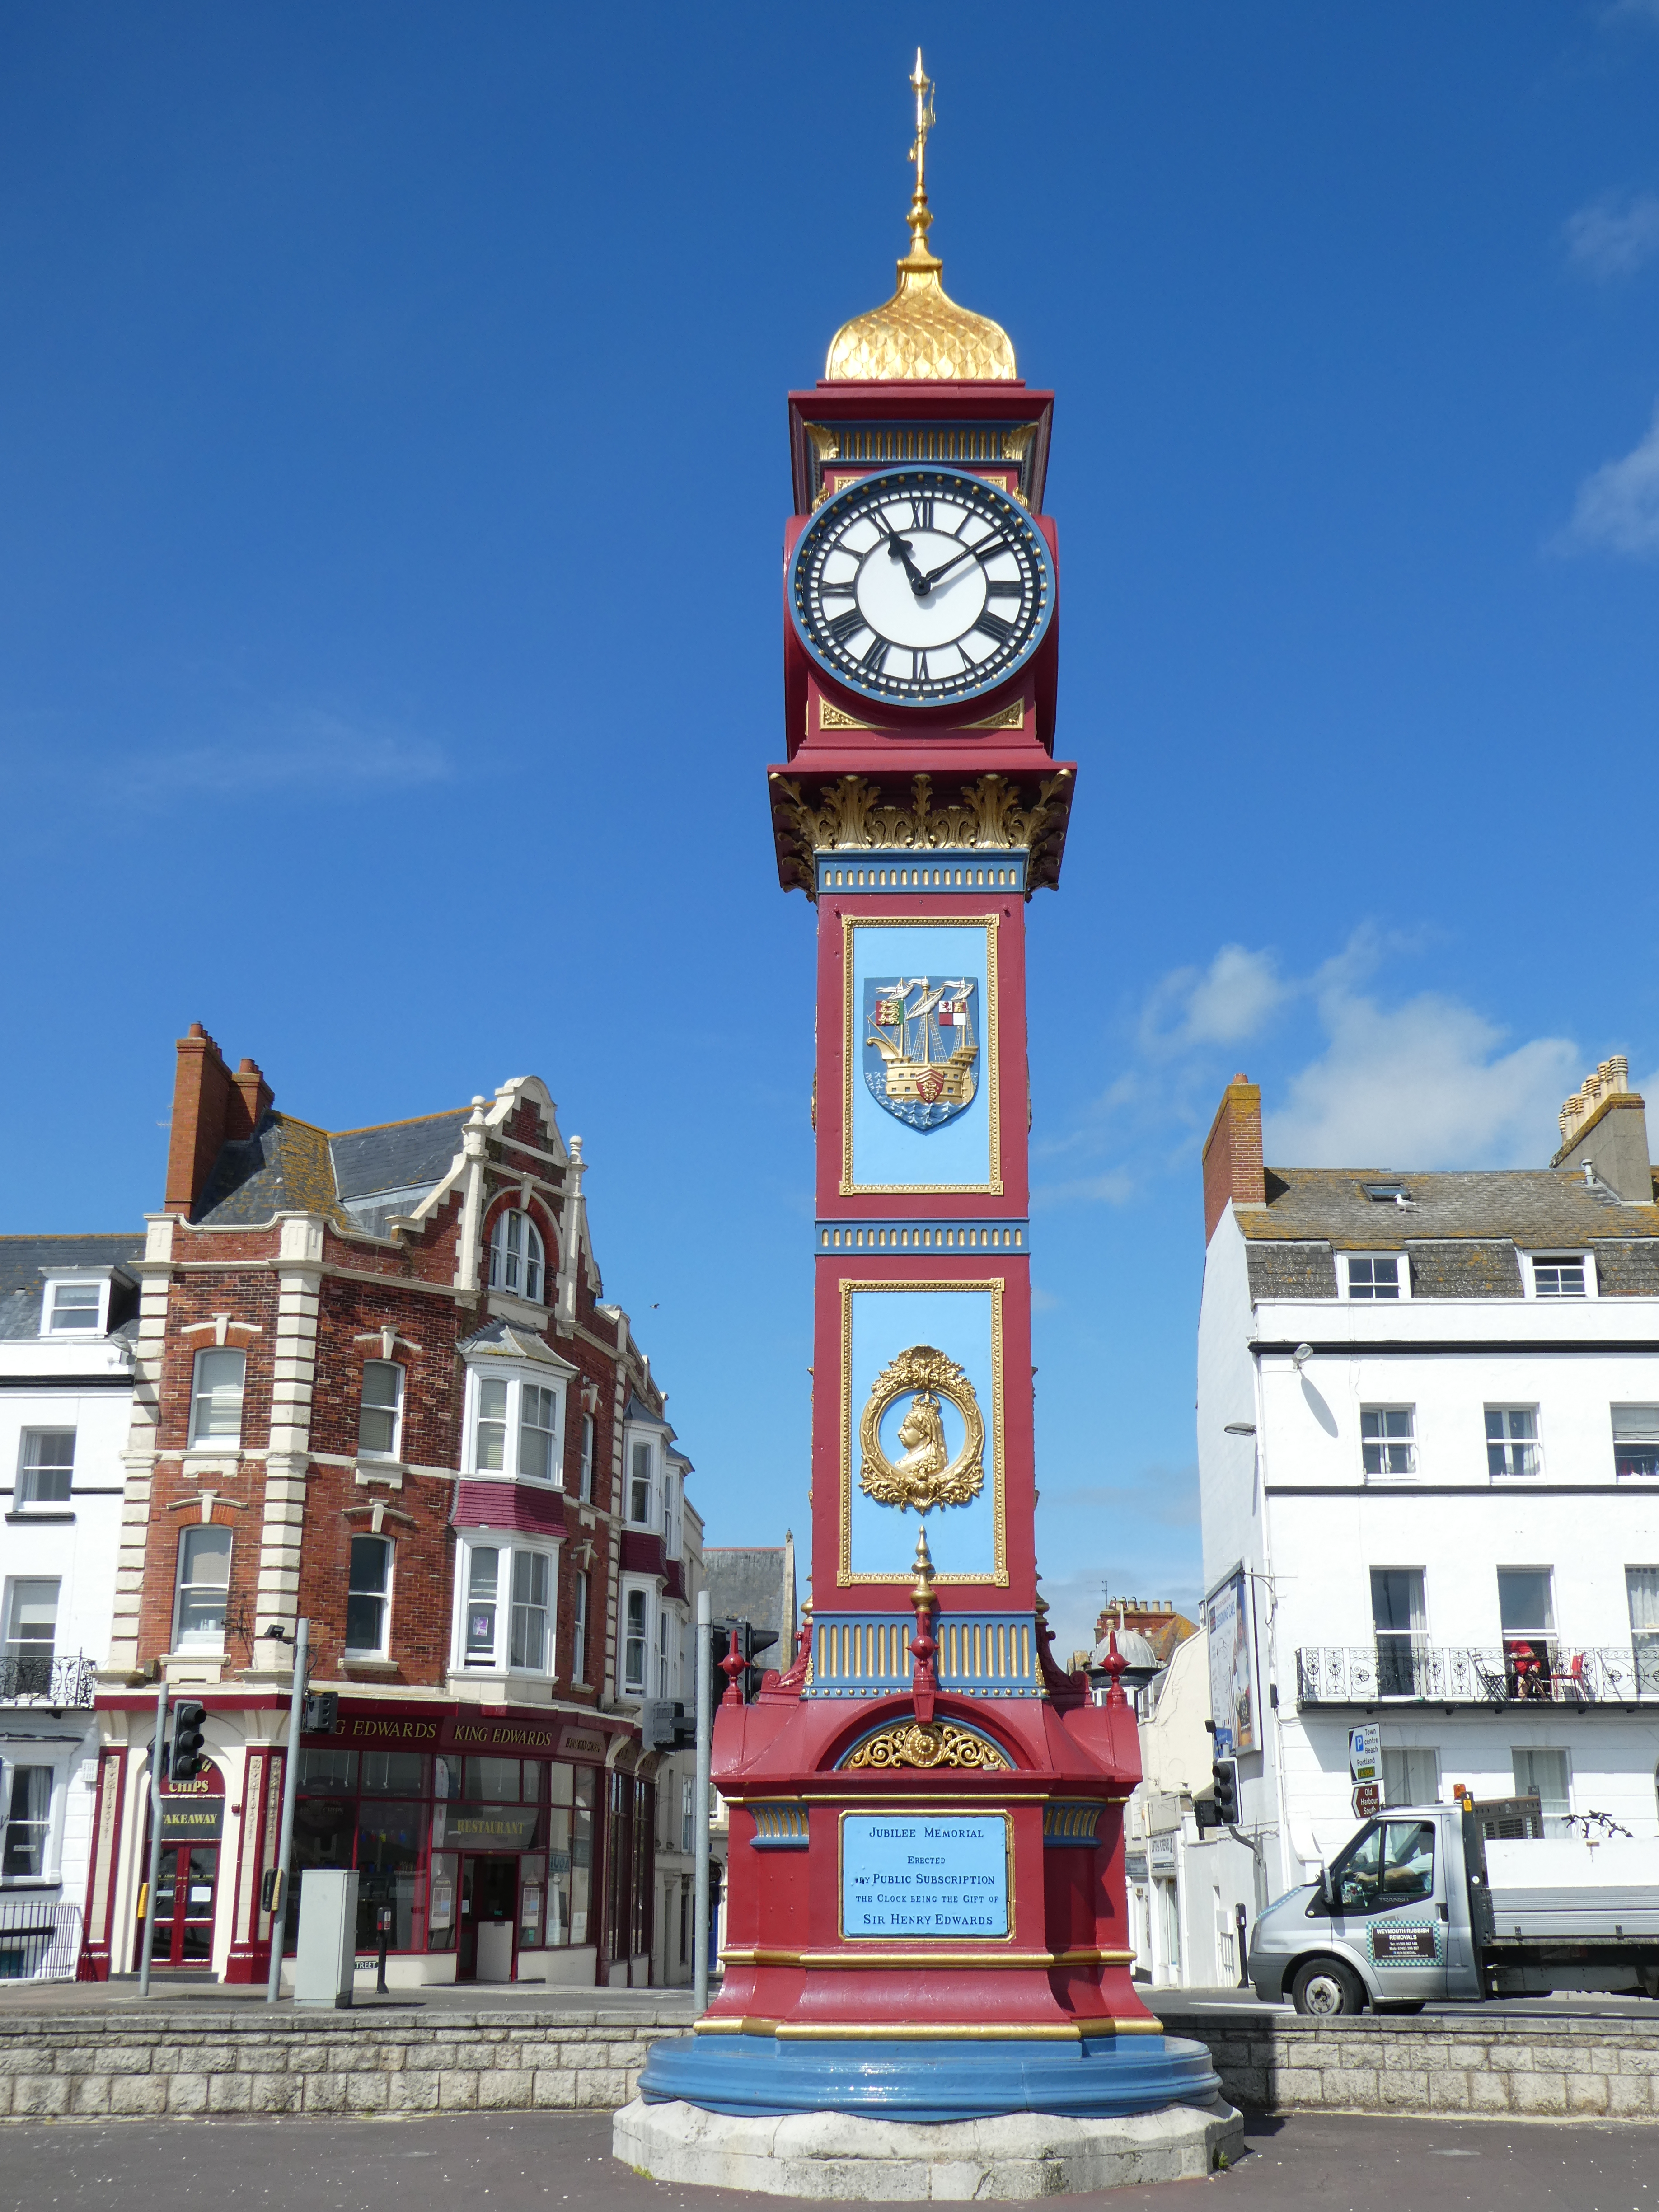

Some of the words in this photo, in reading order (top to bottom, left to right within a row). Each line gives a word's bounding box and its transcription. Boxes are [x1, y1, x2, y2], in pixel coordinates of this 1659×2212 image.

[911, 497, 933, 529] XII
[352, 1720, 436, 1738] EDWARDS
[454, 1725, 488, 1742] KING
[492, 1728, 552, 1746] EDWARDS
[1365, 1746, 1378, 1754] Beach
[1357, 1757, 1375, 1766] Portland
[169, 1780, 209, 1792] CHIPS
[1360, 1797, 1378, 1806] Harbour
[457, 1819, 525, 1835] RESTAURANT
[869, 1827, 916, 1837] JUBILEE
[924, 1827, 984, 1837] MEMORIAL
[907, 1856, 945, 1864] ERECTED
[859, 1876, 870, 1884] BY
[873, 1873, 911, 1884] PUBLIC
[916, 1873, 994, 1884] SUBSCRIPTION
[877, 1894, 906, 1902] CLOCK
[963, 1894, 984, 1903] GIFT
[863, 1914, 885, 1924] SIR
[890, 1913, 931, 1925] HENRY
[935, 1914, 992, 1925] EDWARDS
